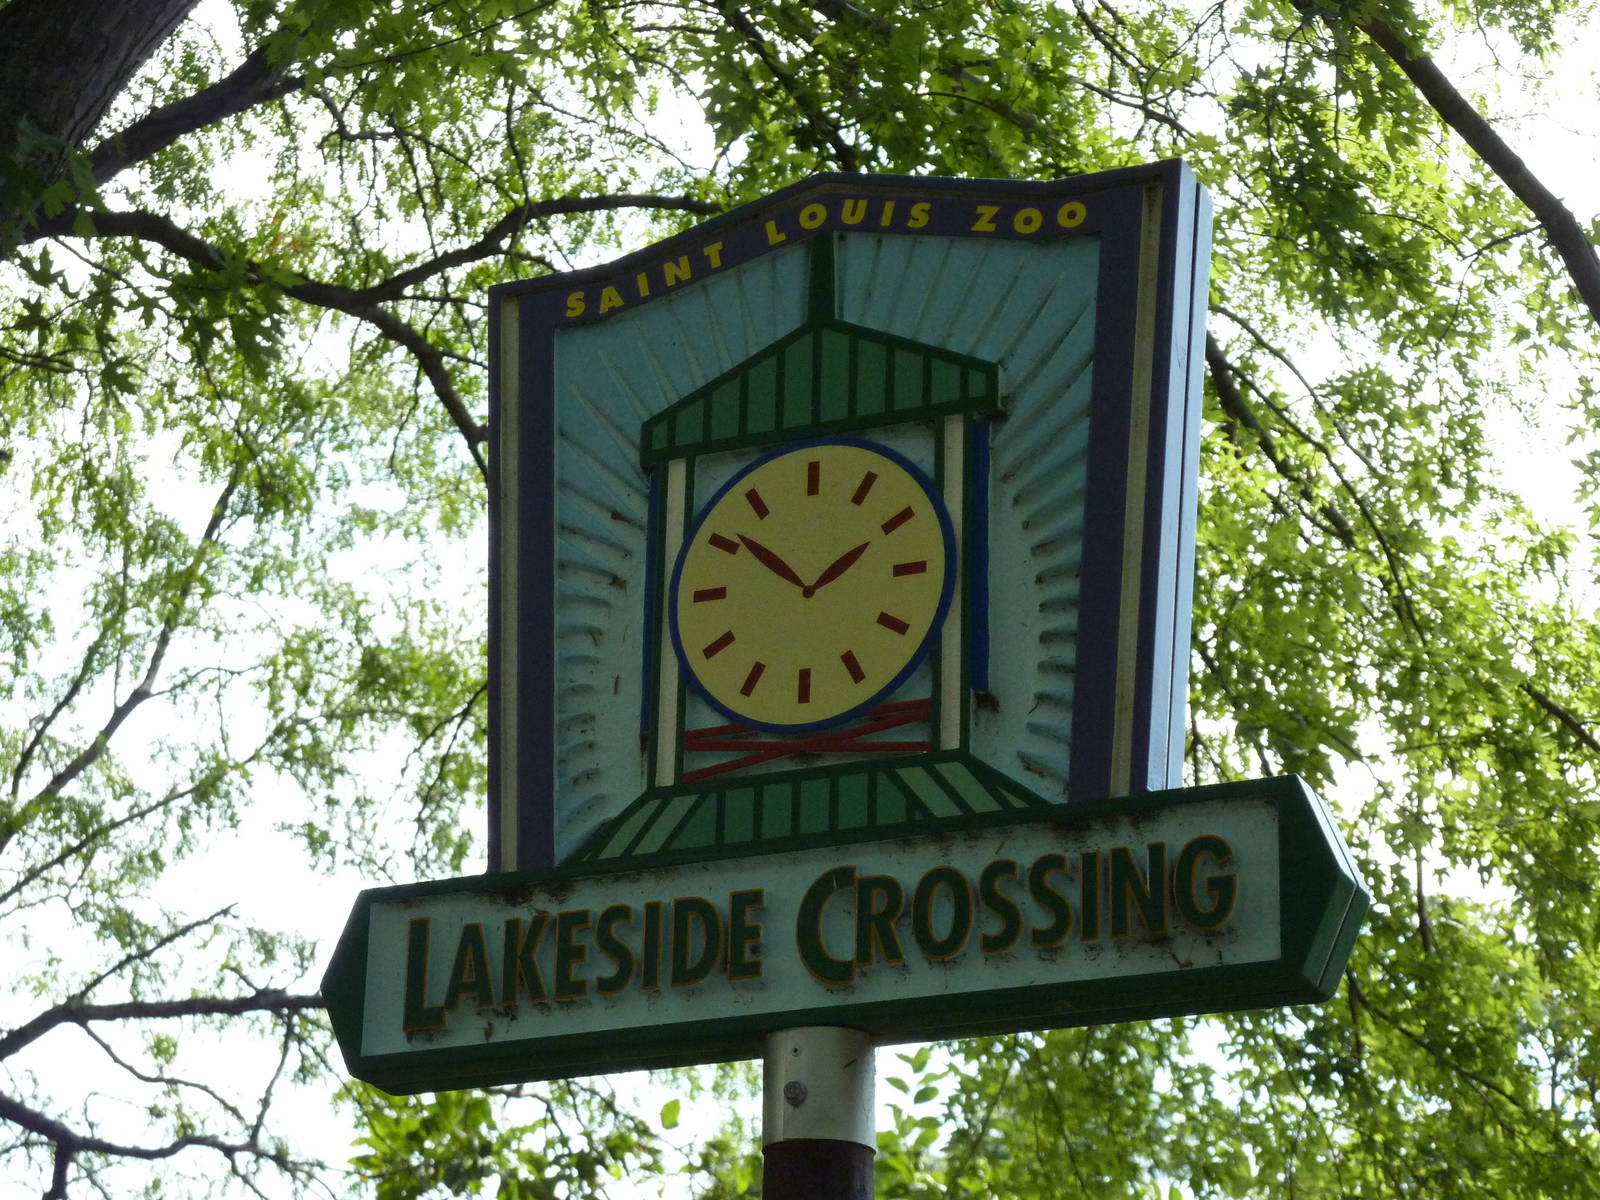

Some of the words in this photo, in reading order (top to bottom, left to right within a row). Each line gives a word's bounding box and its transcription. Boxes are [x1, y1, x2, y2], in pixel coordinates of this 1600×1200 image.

[564, 240, 724, 318] SAINT
[765, 198, 933, 246] LOUIS
[970, 201, 1088, 235] ZOO
[403, 888, 765, 1033] LAKESIDE
[796, 834, 1238, 986] CROSSING
